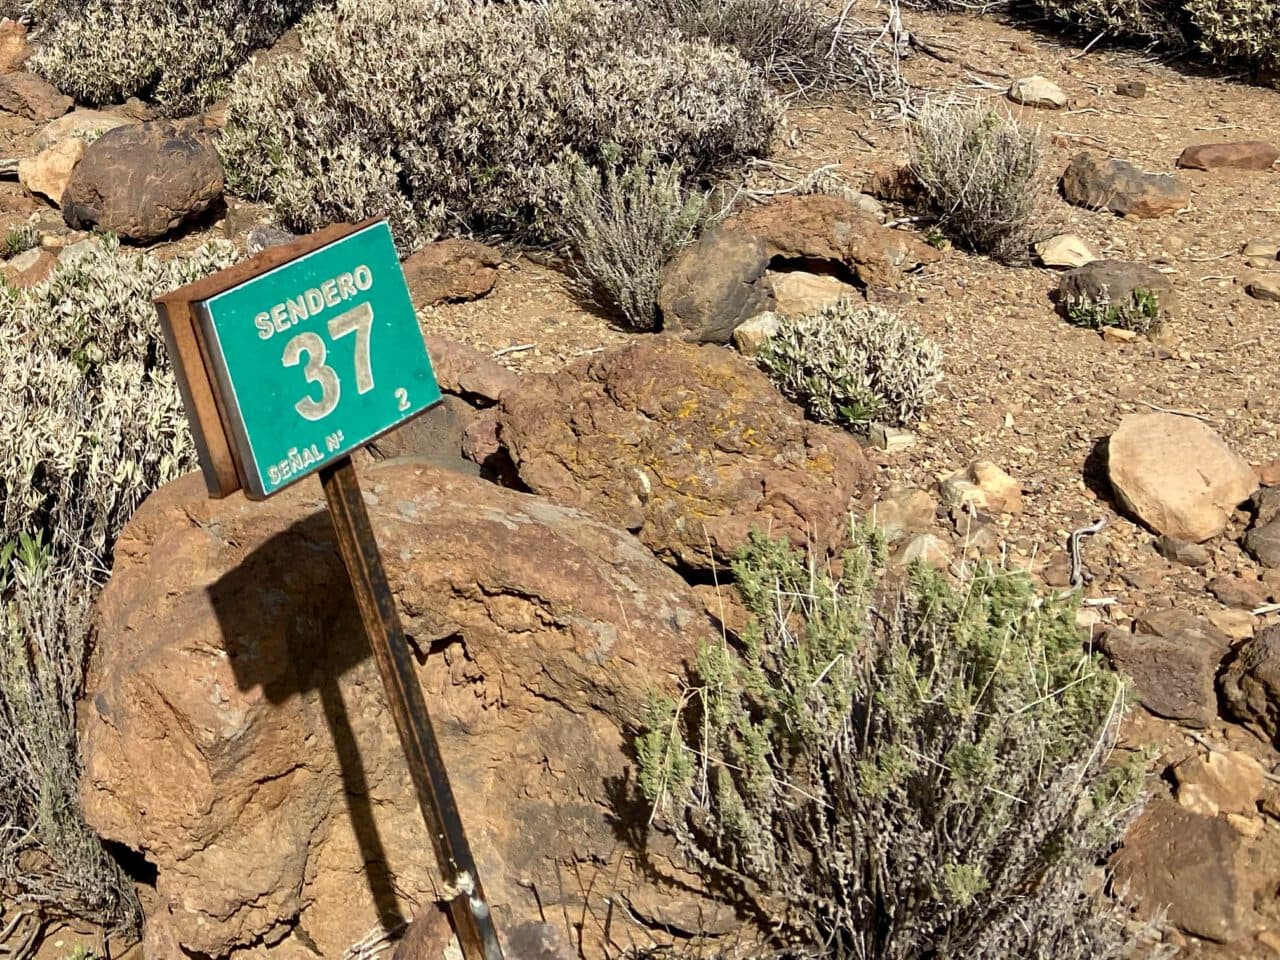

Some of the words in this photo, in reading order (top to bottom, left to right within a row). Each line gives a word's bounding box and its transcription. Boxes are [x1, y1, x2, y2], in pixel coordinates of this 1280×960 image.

[255, 265, 373, 340] SENDERO
[282, 301, 374, 421] 37
[267, 447, 324, 485] SEÑAL
[394, 388, 411, 411] 2
